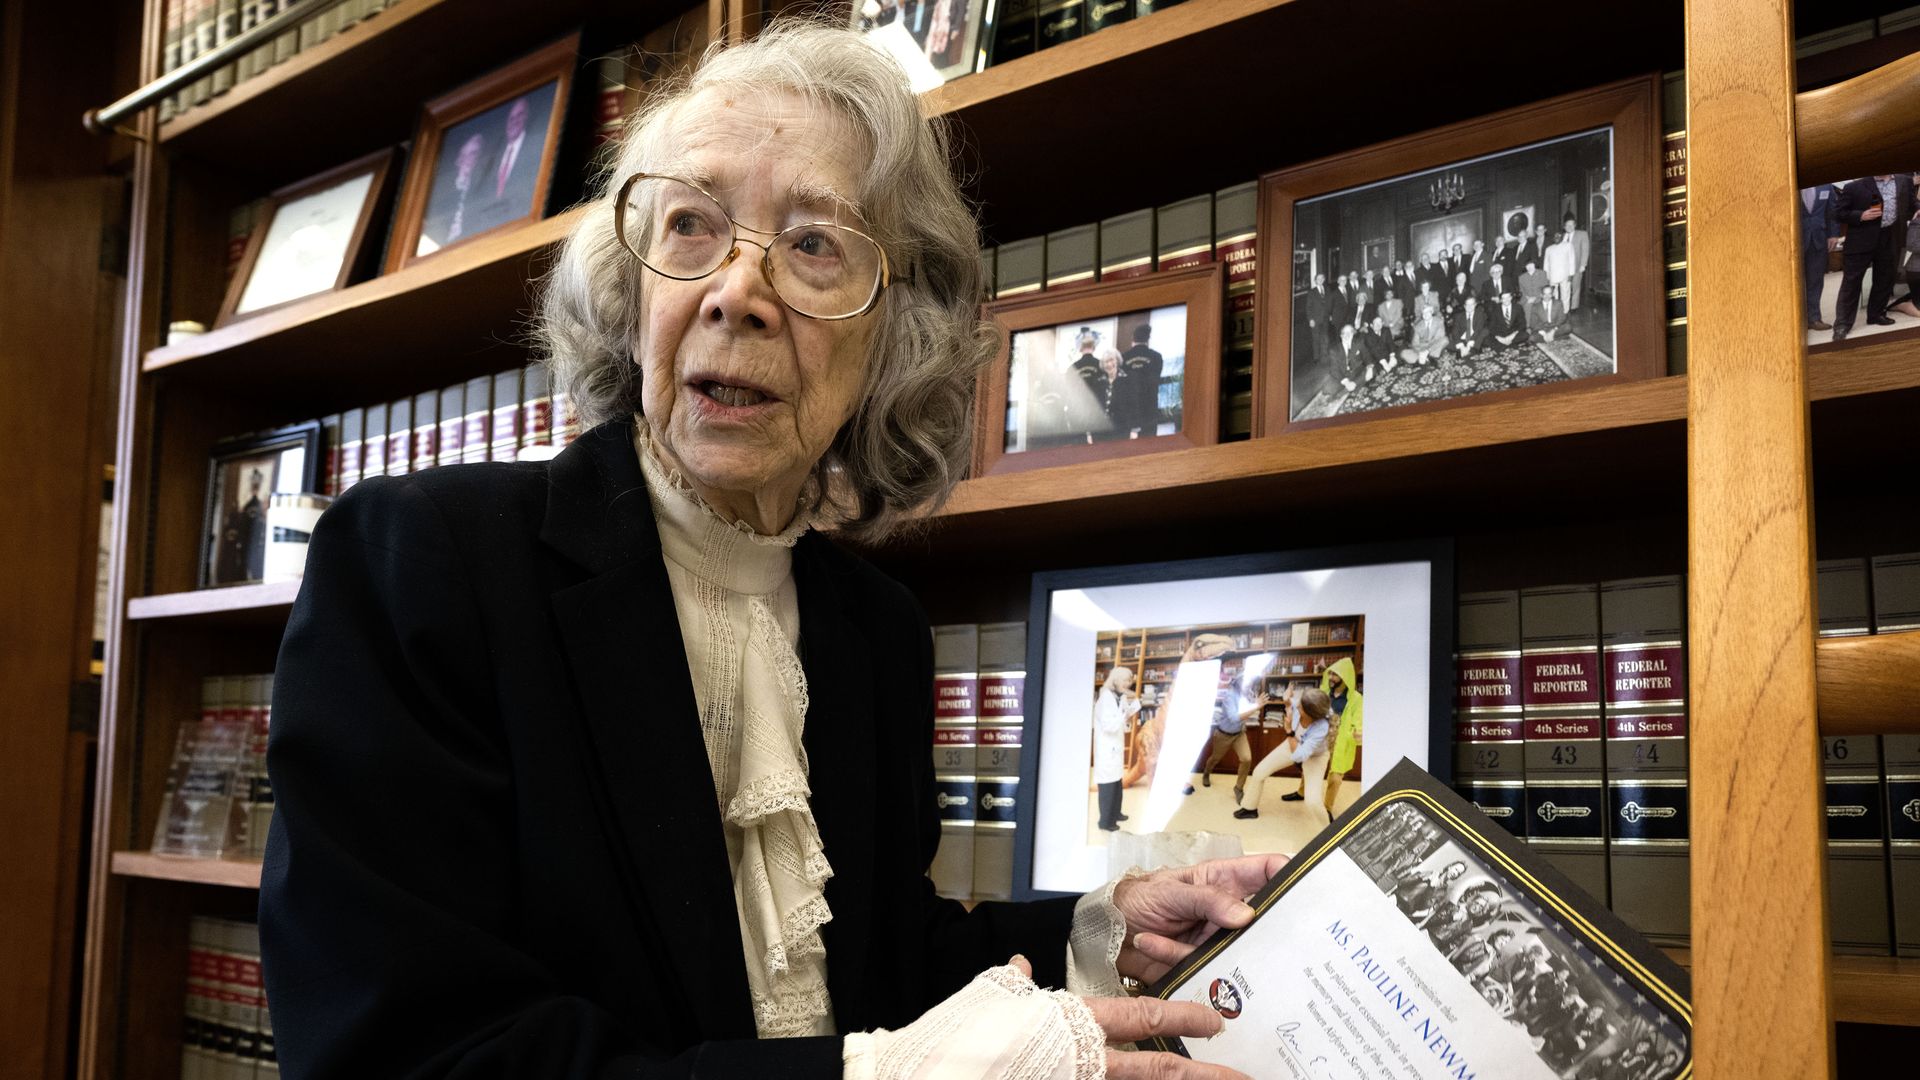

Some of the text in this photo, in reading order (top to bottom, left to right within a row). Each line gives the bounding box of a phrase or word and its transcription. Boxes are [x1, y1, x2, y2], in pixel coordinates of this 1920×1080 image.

[1225, 248, 1255, 262] FEDERA
[1230, 261, 1256, 275] PORTE
[1536, 664, 1583, 677] FEDERAL
[1618, 659, 1667, 673] FEDERAL
[1463, 668, 1508, 680] FEDERAL
[985, 685, 1017, 696] FEDERAL
[1460, 684, 1512, 697] REPORTER
[1533, 680, 1588, 693] REPORTER
[1615, 677, 1672, 691] REPORTER
[939, 686, 969, 697] FEDERAL
[938, 699, 971, 710] REPORTER
[984, 698, 1019, 709] REPORTER
[1461, 726, 1512, 736] 4th Series
[1534, 723, 1589, 734] 4th Series
[1617, 721, 1673, 732] 4th Series
[995, 732, 1018, 742] Series
[945, 750, 961, 766] 33
[1474, 750, 1500, 769] 42
[1551, 745, 1577, 766] 43
[1632, 743, 1660, 764] 44
[1325, 919, 1354, 951] MS.
[1350, 944, 1419, 1022] PAULINE
[1229, 965, 1255, 1000] NATIONAL
[1405, 966, 1442, 1008] recognition
[1440, 1005, 1458, 1023] that
[1311, 977, 1334, 1005] memory
[1331, 1003, 1348, 1019] and
[1343, 1015, 1366, 1044] history
[1306, 1000, 1327, 1028] Women
[1324, 1026, 1350, 1057] Airforce
[1358, 1005, 1390, 1039] essential
[1385, 1037, 1401, 1054] role
